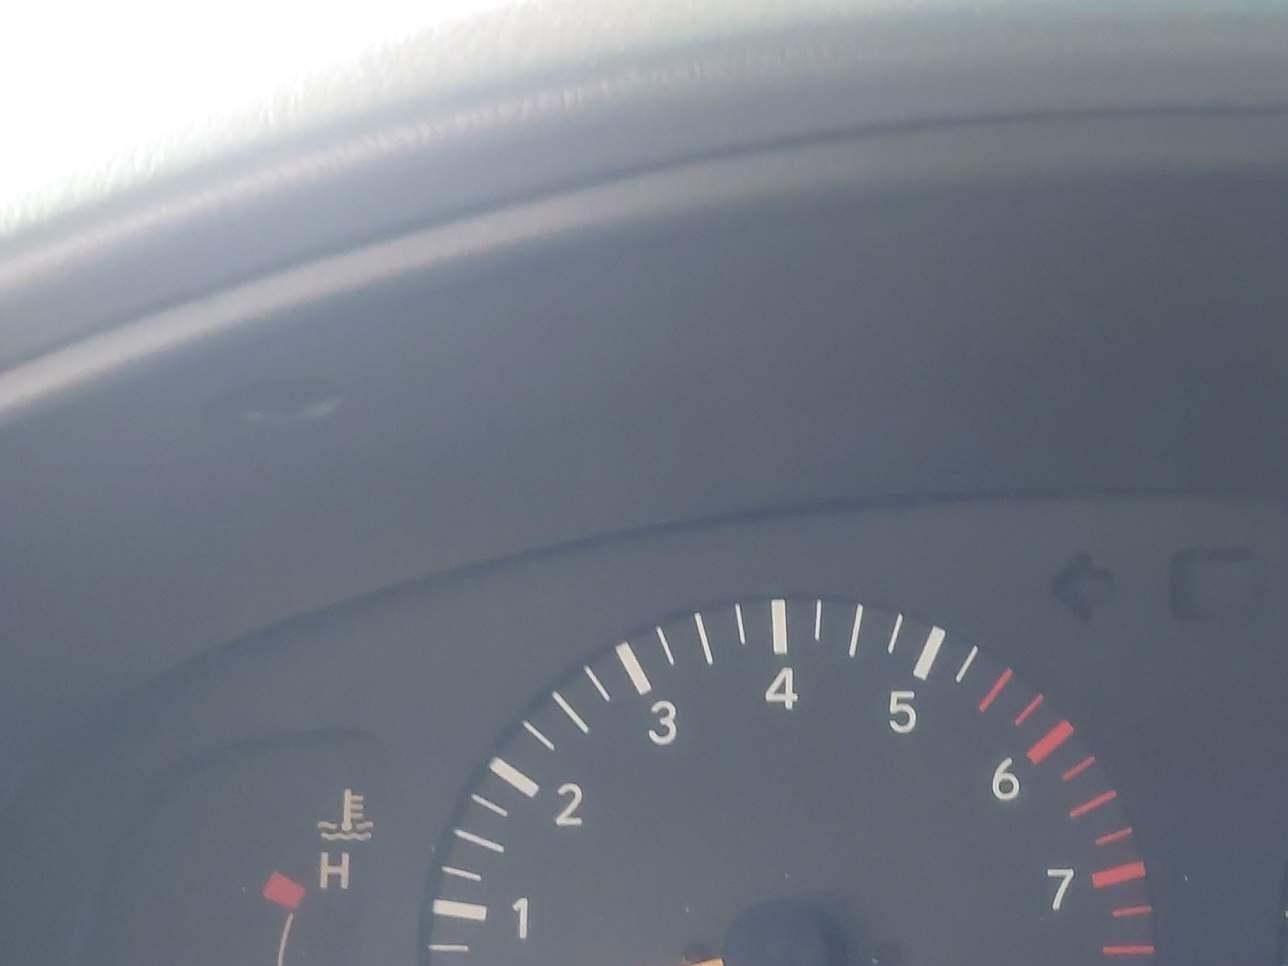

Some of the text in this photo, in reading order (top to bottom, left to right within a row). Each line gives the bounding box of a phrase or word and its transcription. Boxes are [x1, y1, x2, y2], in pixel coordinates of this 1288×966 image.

[766, 668, 798, 709] 4
[649, 701, 676, 745] 3
[890, 691, 916, 733] 5
[993, 758, 1019, 800] 6
[556, 784, 582, 825] 2
[320, 852, 349, 889] H
[1048, 869, 1074, 910] 7
[513, 898, 528, 938] 1
